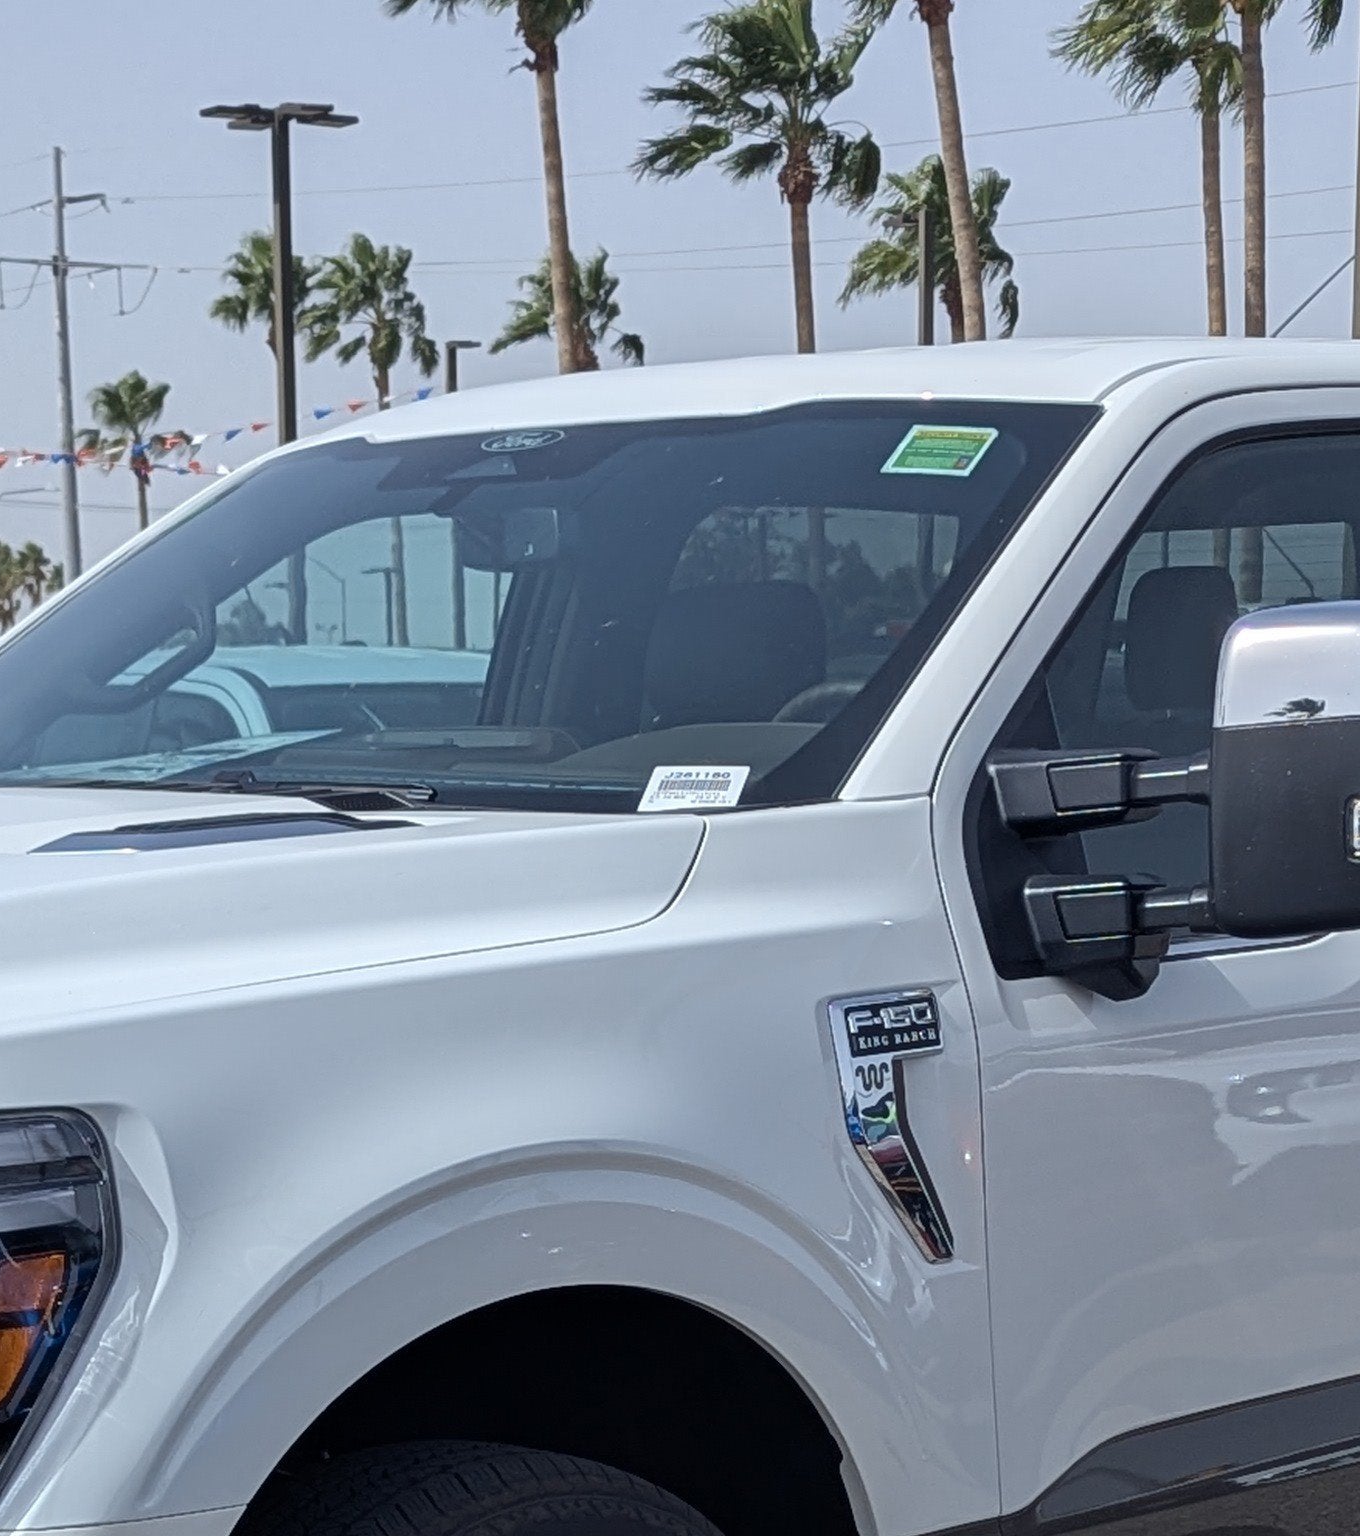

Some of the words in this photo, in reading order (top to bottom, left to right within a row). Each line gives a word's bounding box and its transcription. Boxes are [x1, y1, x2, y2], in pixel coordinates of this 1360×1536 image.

[847, 1002, 936, 1034] F-150
[858, 1035, 890, 1050] KING
[893, 1027, 937, 1046] RANCH
